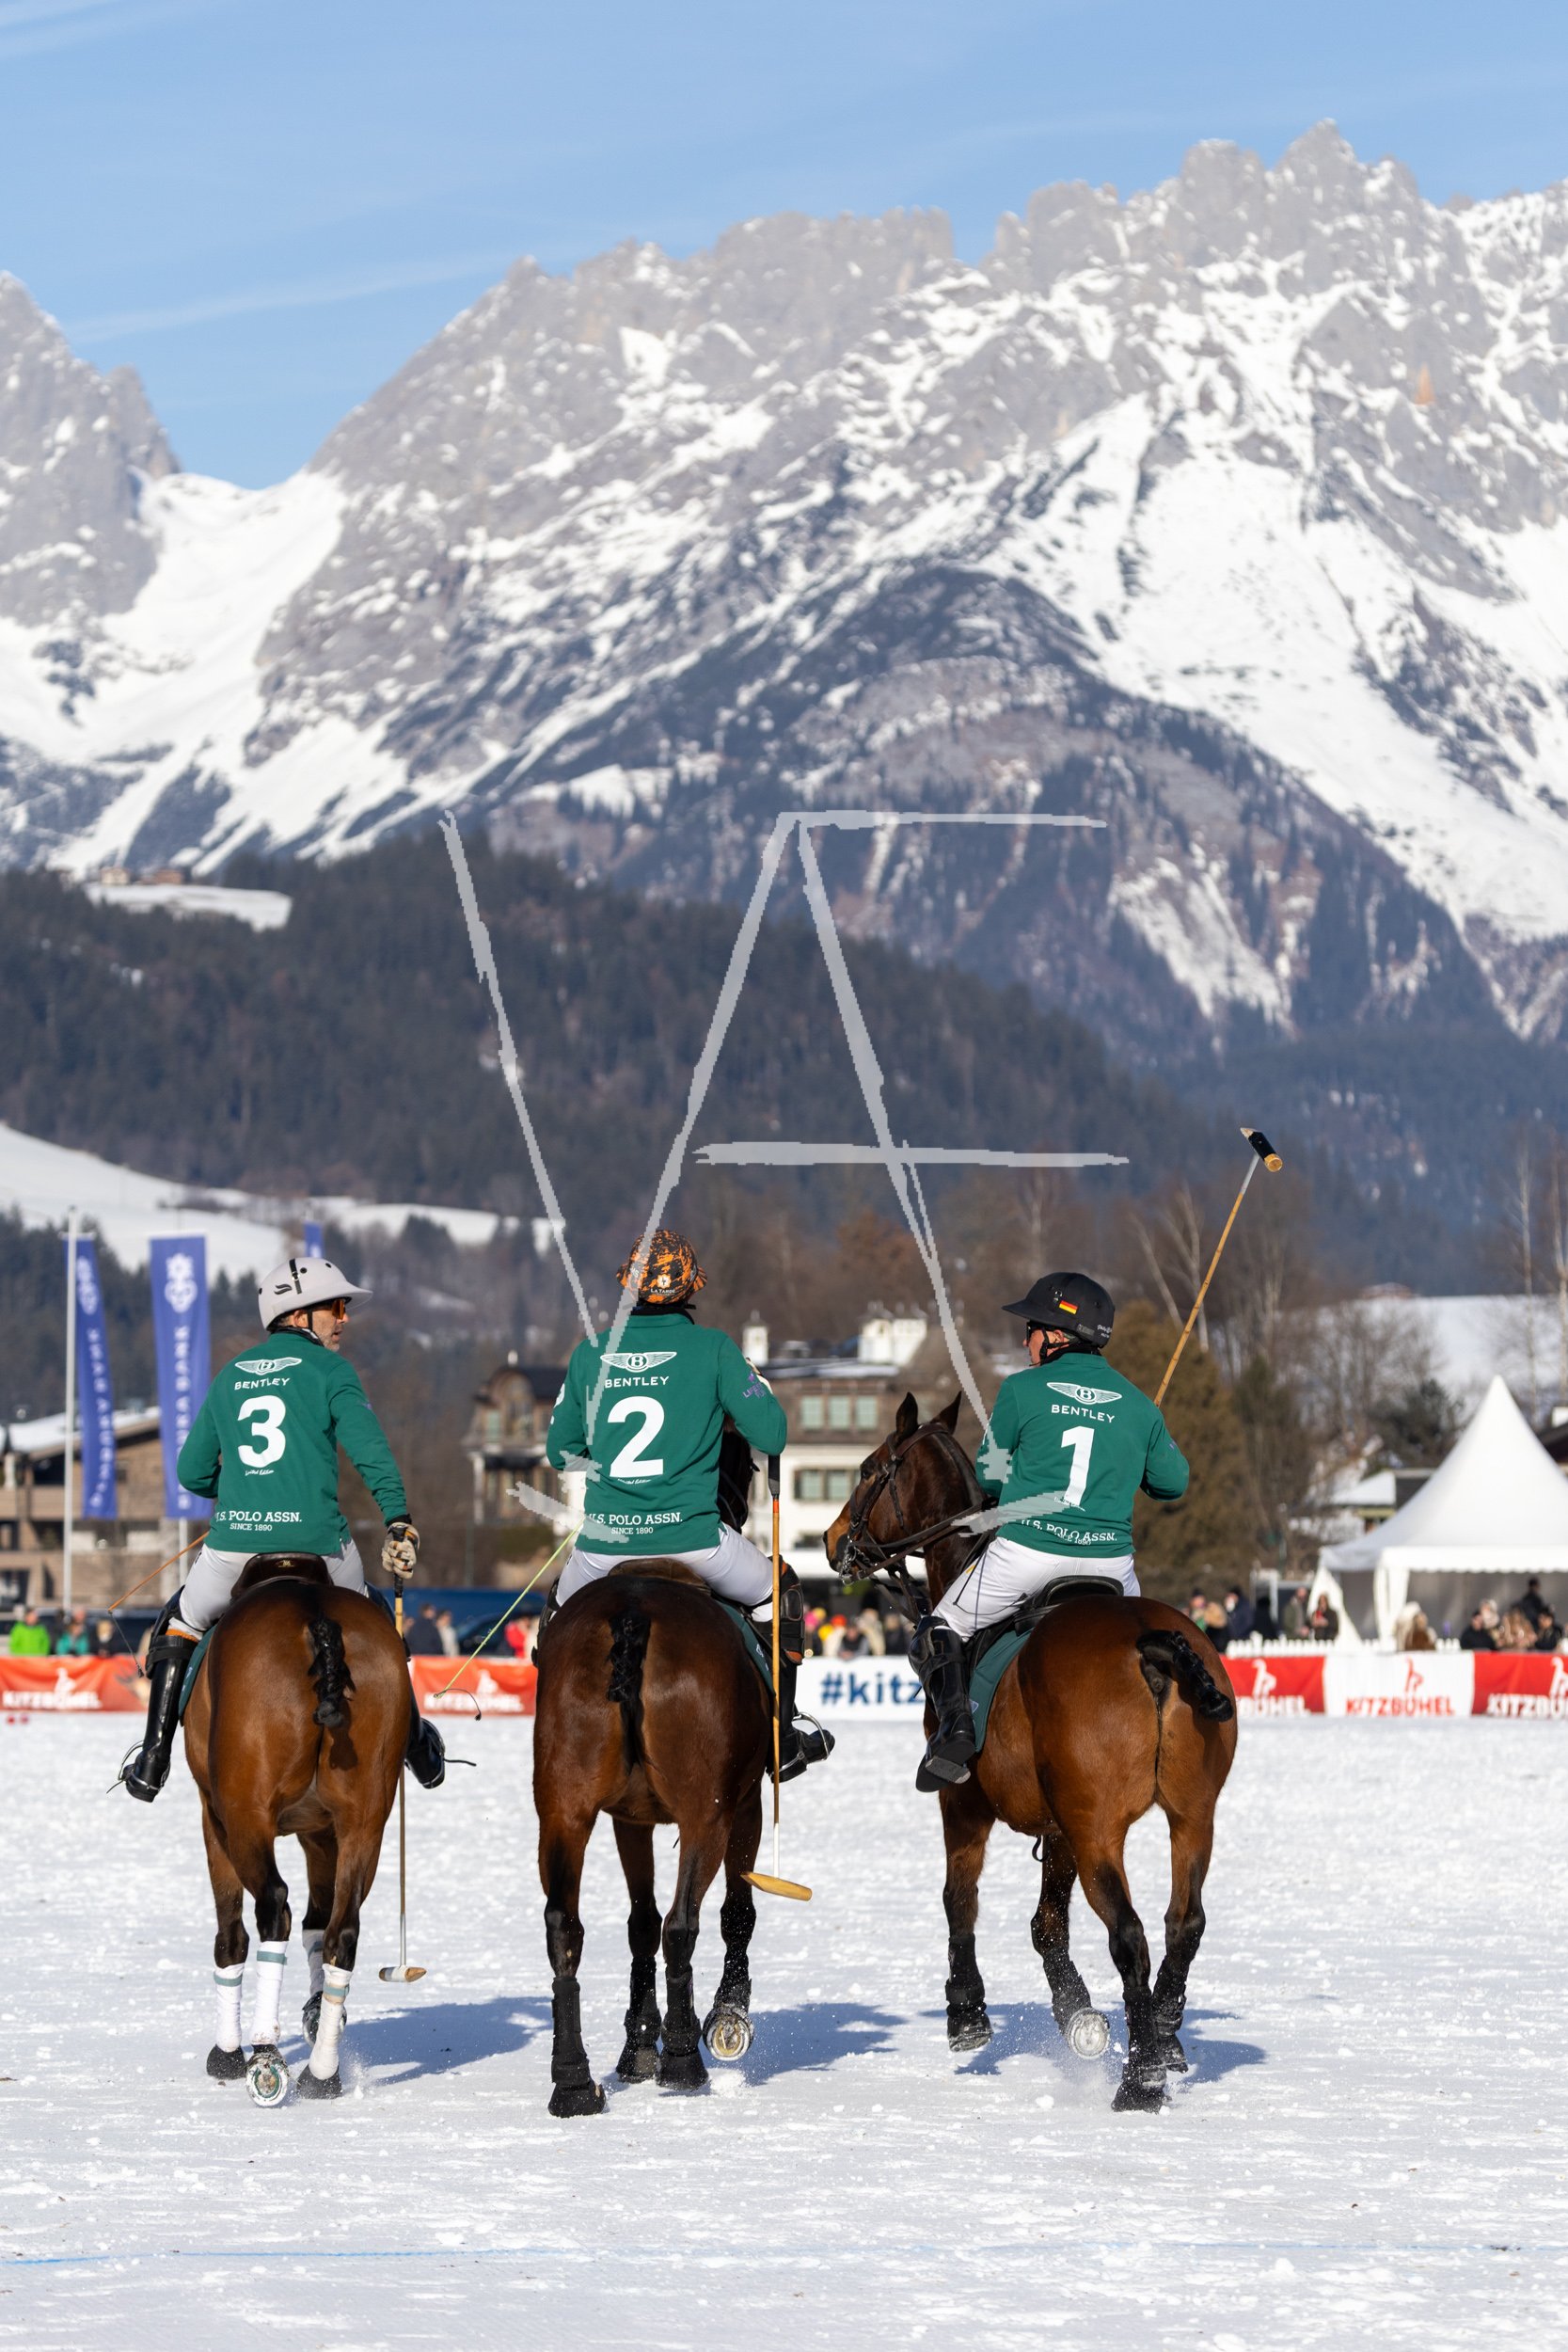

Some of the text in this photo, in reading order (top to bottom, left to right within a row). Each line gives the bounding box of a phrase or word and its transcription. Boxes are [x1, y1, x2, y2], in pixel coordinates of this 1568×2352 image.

[234, 1377, 291, 1391] BENTLEY
[604, 1375, 670, 1389] BENTLEY
[1051, 1404, 1116, 1423] BENTLEY
[237, 1394, 286, 1468] 3
[608, 1395, 665, 1478] 2
[1061, 1425, 1095, 1506] 1
[229, 1510, 262, 1522] POLO
[263, 1512, 302, 1523] ASSN.
[609, 1514, 641, 1525] POLO
[644, 1512, 683, 1524] ASSN.
[230, 1522, 252, 1531] SINCE
[635, 1526, 654, 1534] 1890
[1046, 1523, 1080, 1539] POLO
[1082, 1532, 1117, 1542] ASSN.
